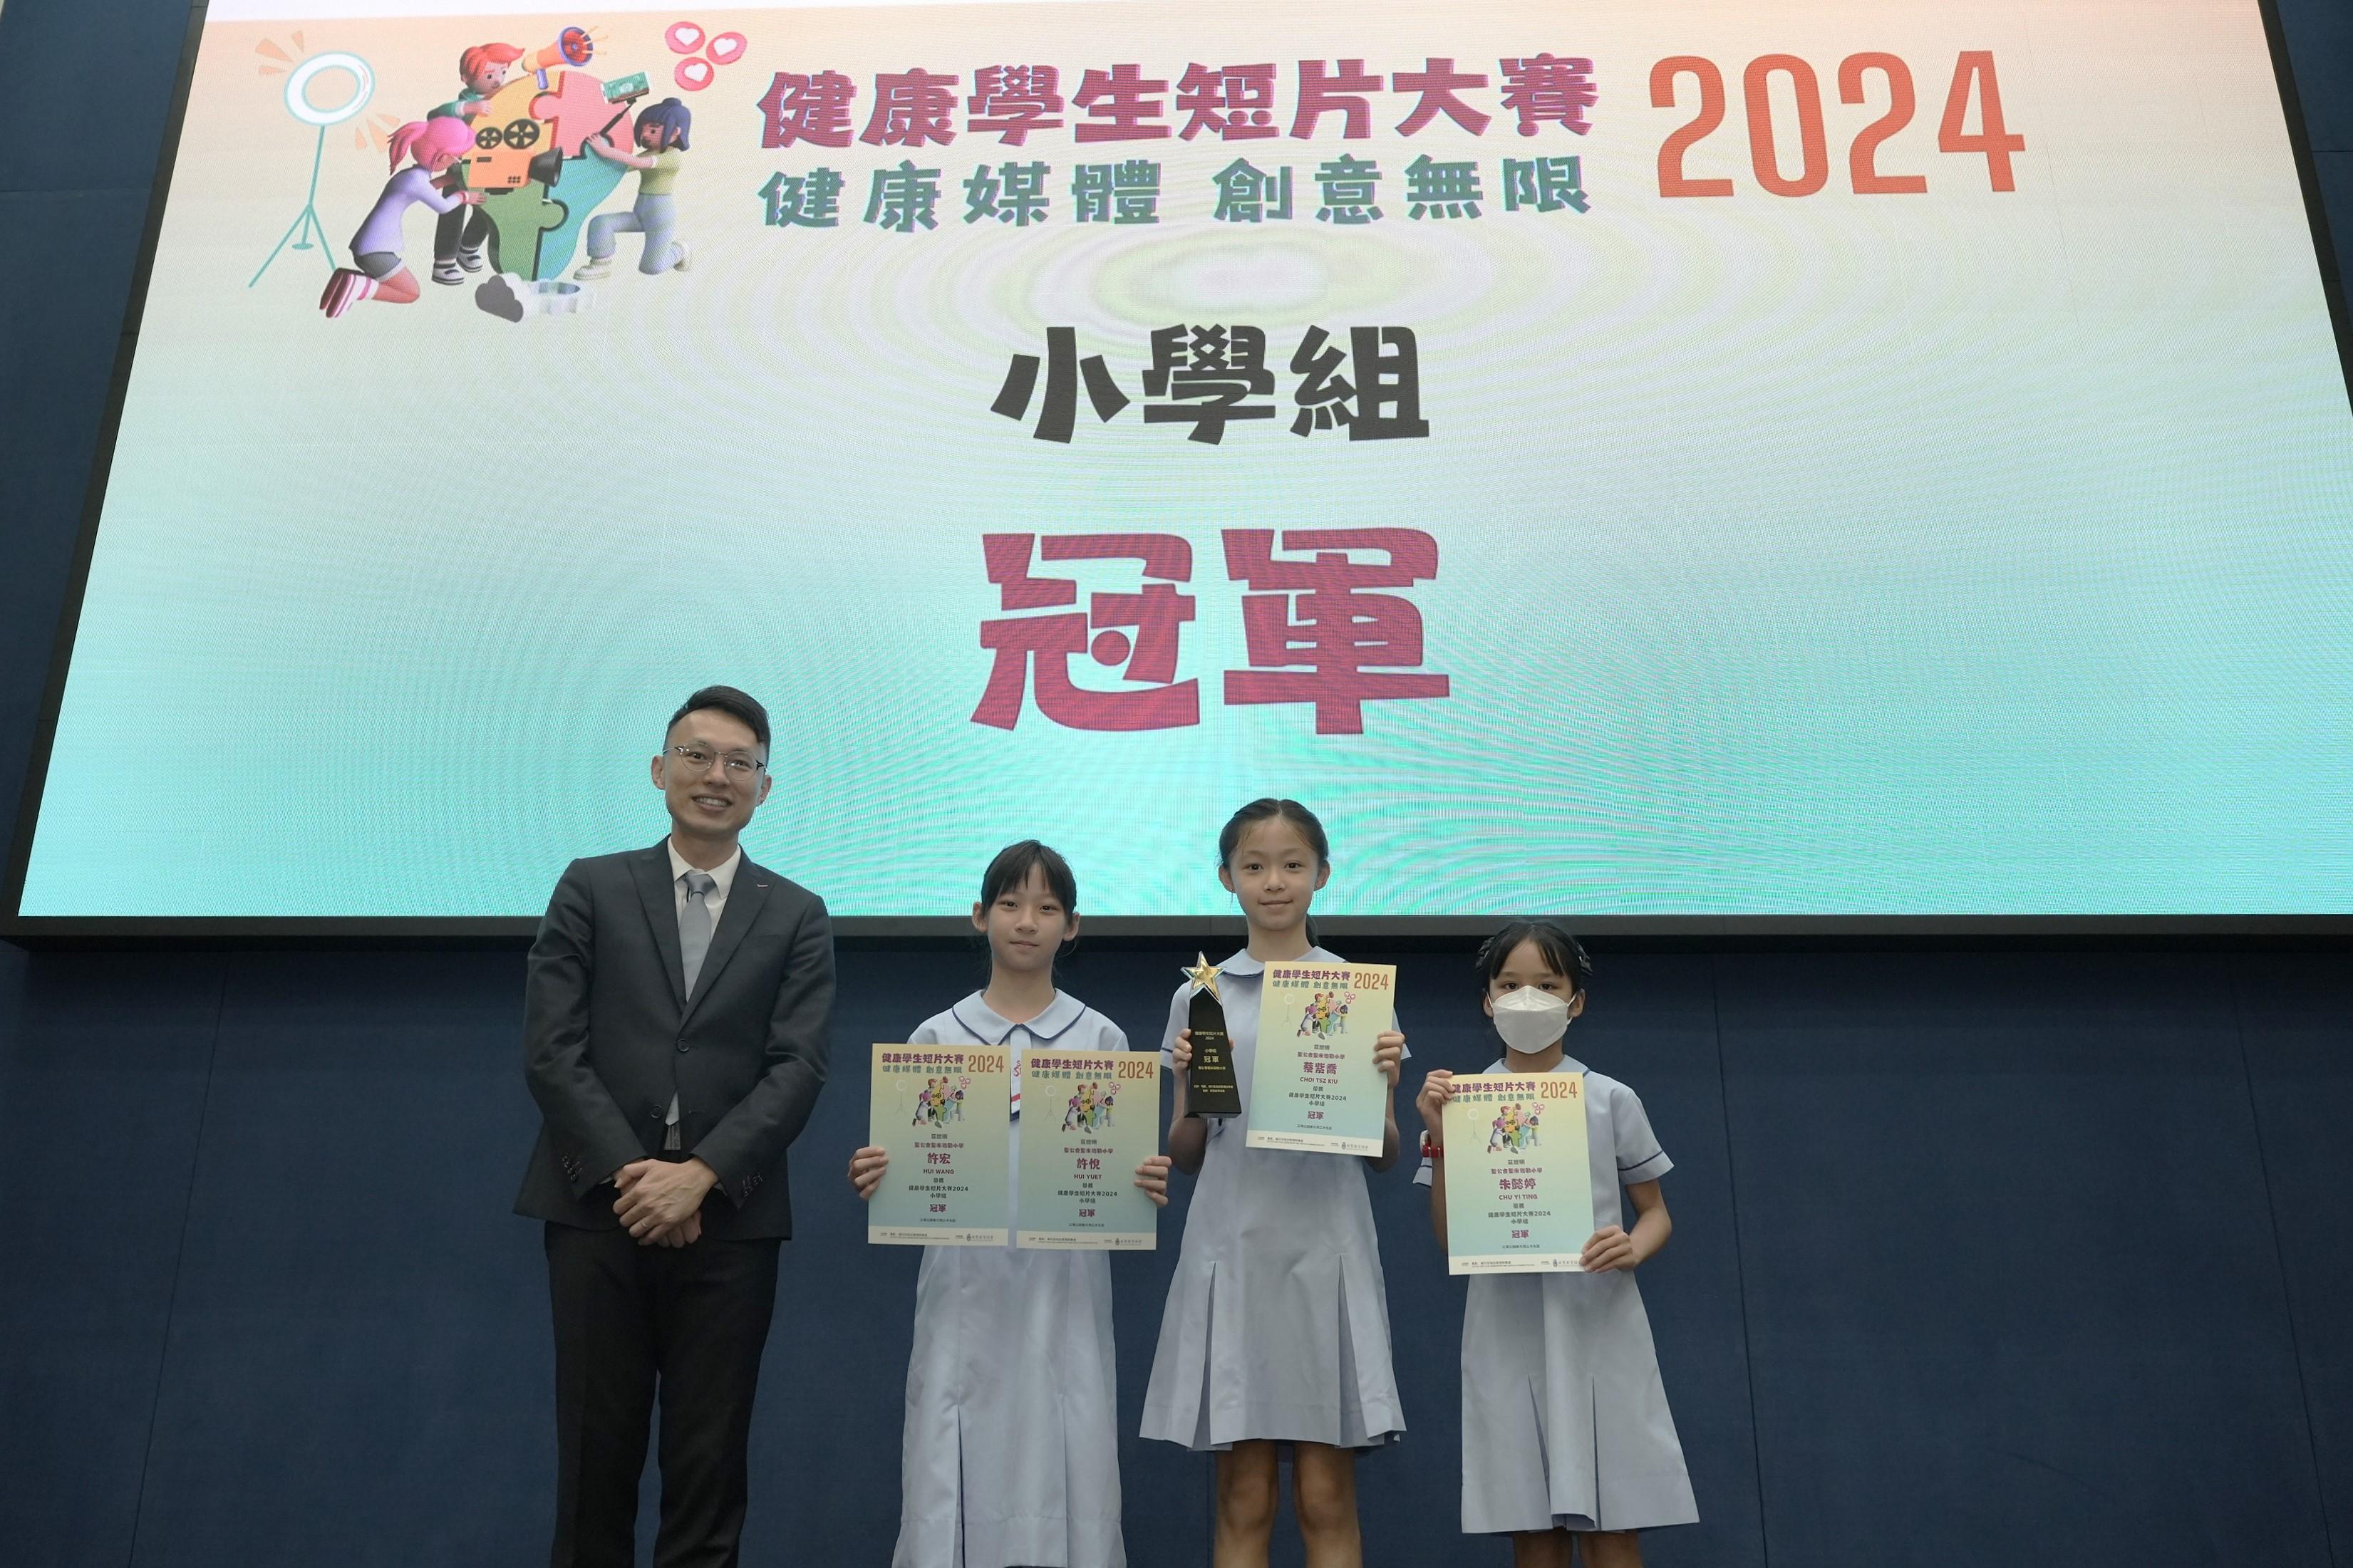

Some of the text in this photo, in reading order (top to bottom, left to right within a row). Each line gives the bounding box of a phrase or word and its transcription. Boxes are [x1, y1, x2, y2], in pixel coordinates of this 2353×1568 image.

[757, 51, 2025, 197] 健康學生短片大賽 2024
[757, 153, 1591, 232] 健康媒體 創意無限
[991, 324, 1429, 445] 小學組
[971, 527, 1449, 734] 冠軍
[1273, 969, 1389, 990] 健康學生短片大賽 2024
[882, 1053, 1004, 1073] 健康學生短片大賽 2024
[1031, 1059, 1154, 1079] 健康學生短片大賽 2024
[1303, 1061, 1338, 1074] 蔡紫喬
[1541, 1081, 1577, 1099] 2024
[1308, 1111, 1324, 1120] 冠軍
[928, 1153, 951, 1164] 許宏
[1077, 1158, 1100, 1170] 許悅
[1499, 1178, 1536, 1190] 朱懿婷
[930, 1204, 946, 1213] 冠軍
[1079, 1209, 1095, 1217] 冠軍
